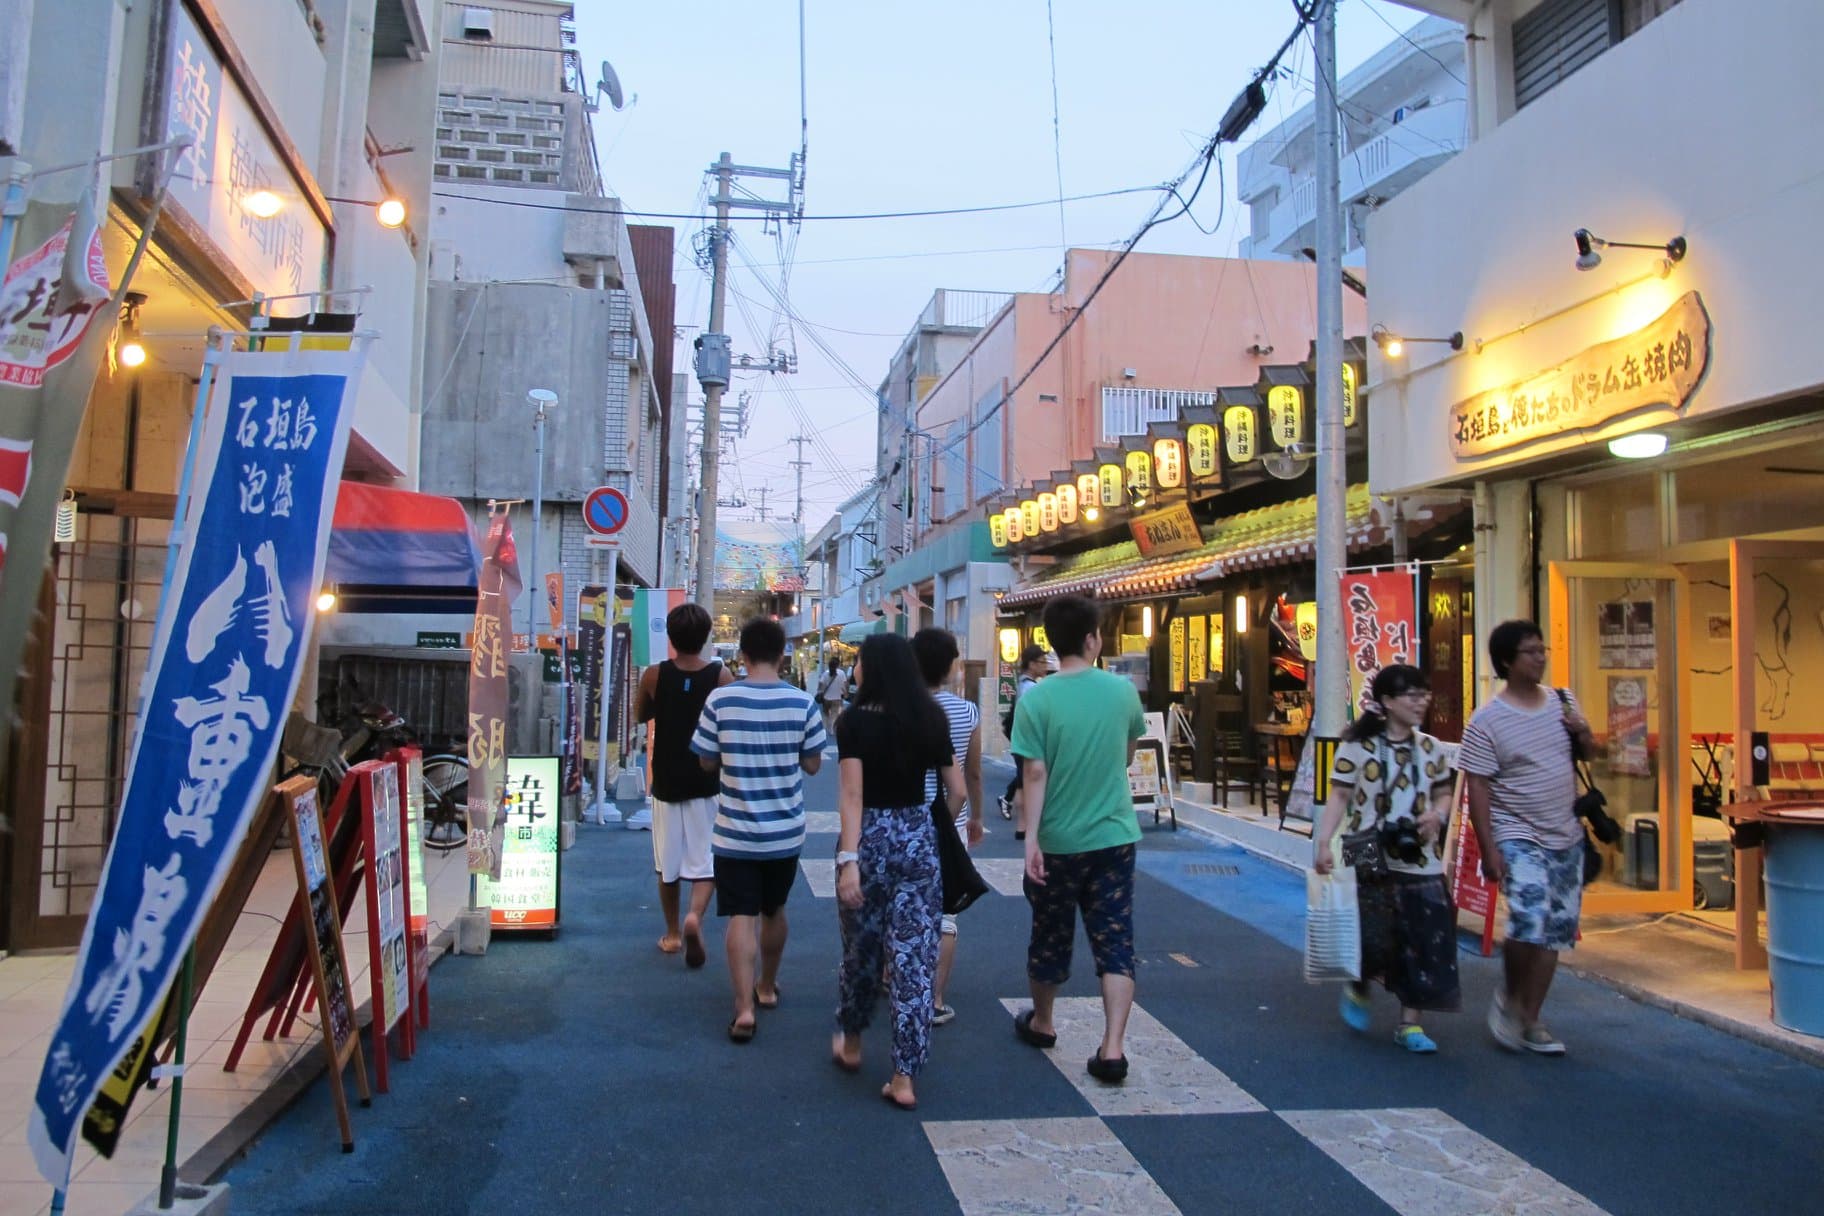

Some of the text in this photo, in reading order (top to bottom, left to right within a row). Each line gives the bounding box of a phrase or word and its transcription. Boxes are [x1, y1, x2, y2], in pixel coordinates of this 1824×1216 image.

[235, 395, 319, 451] 石垣島
[1237, 410, 1249, 456] 沖縄料理
[1283, 389, 1296, 439] 沖縄料理
[238, 461, 297, 519] 泡盛
